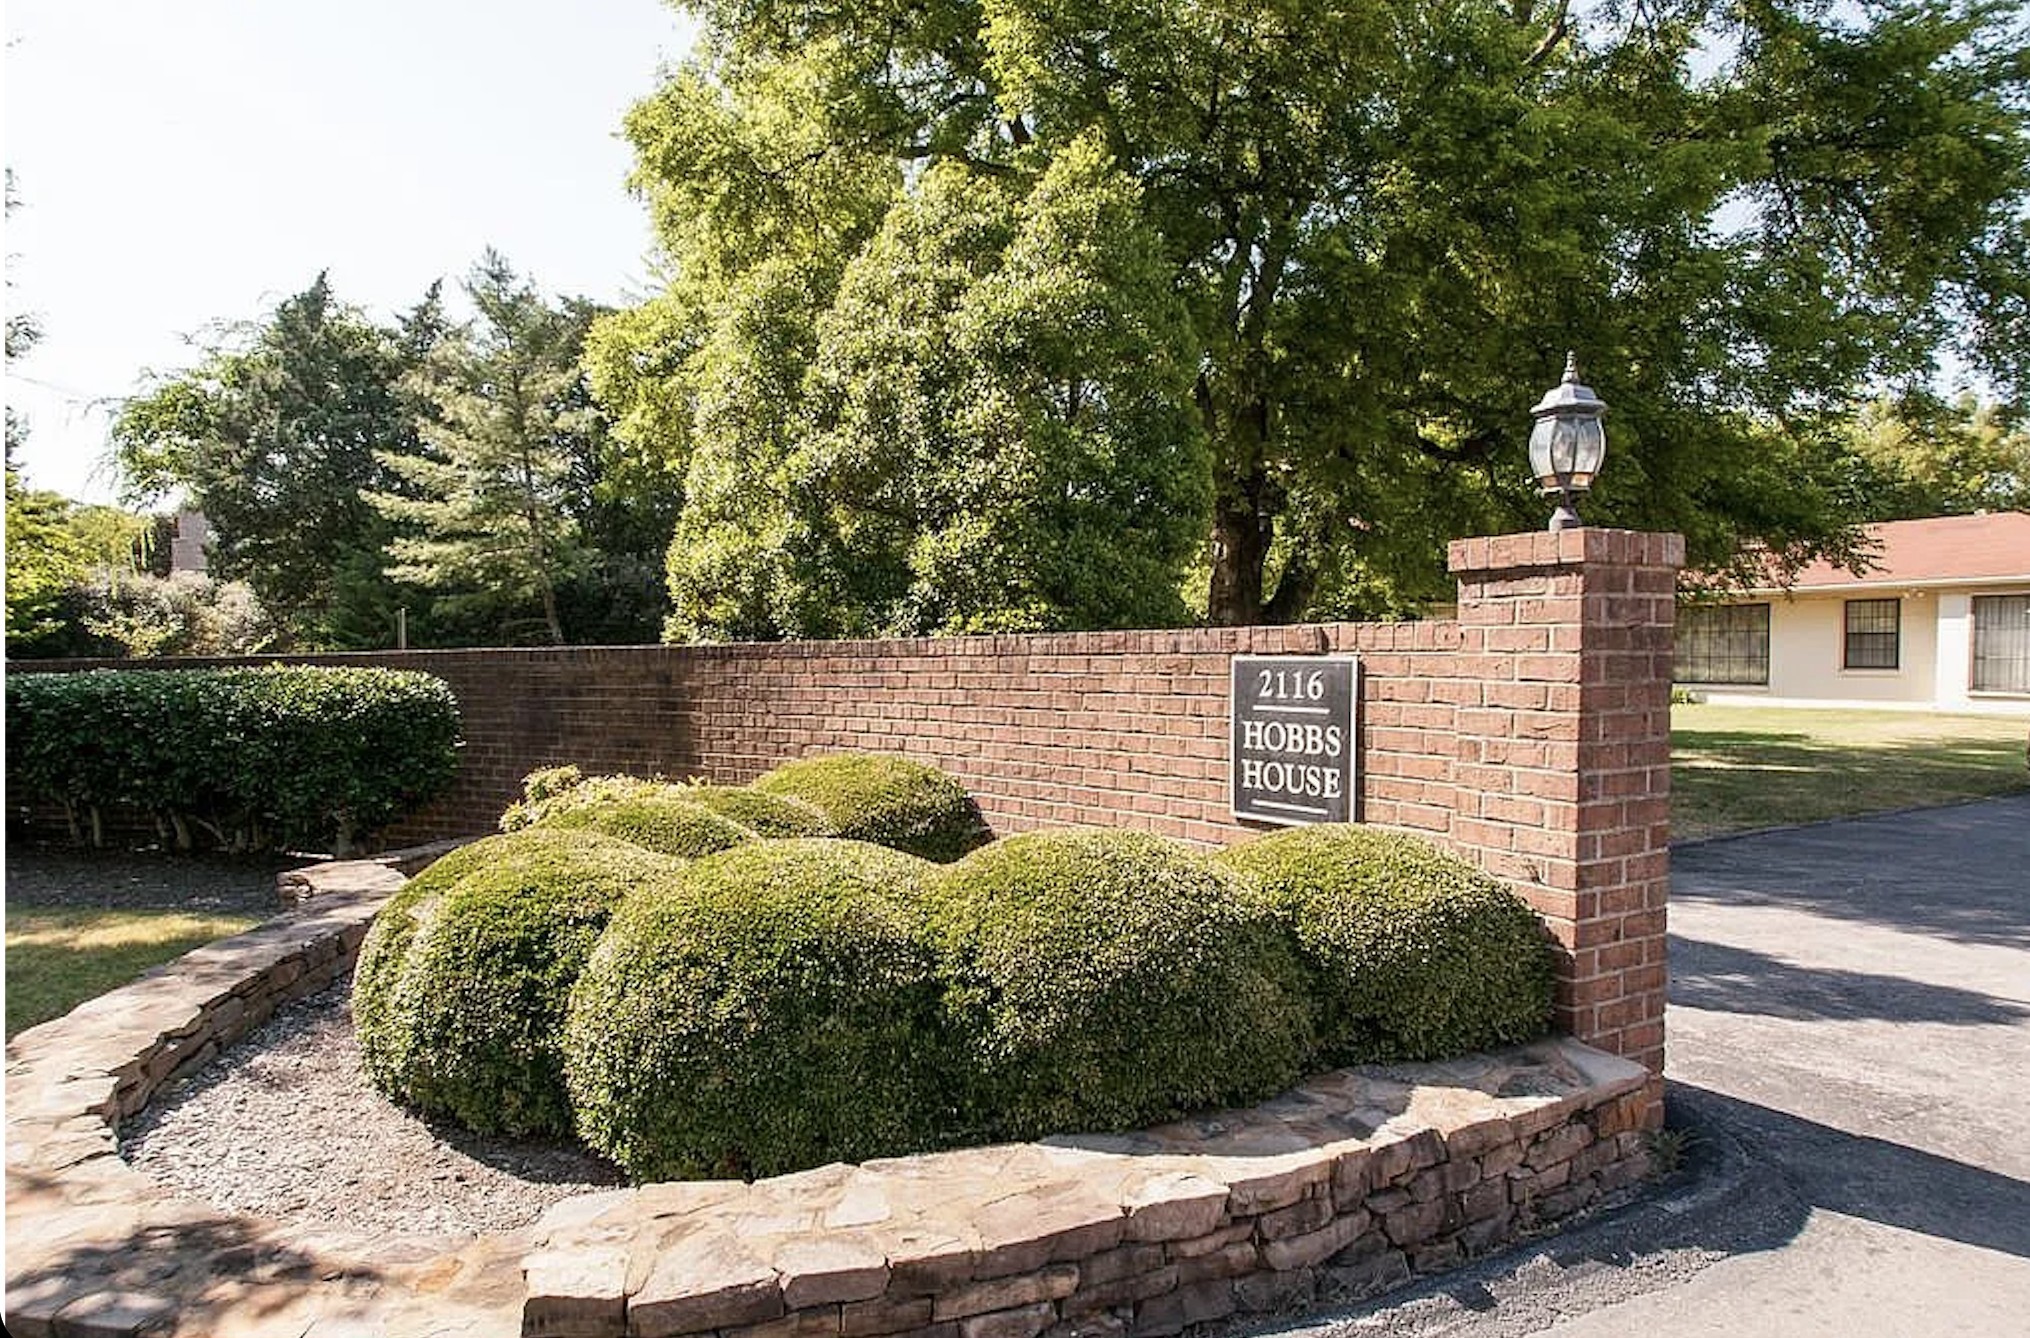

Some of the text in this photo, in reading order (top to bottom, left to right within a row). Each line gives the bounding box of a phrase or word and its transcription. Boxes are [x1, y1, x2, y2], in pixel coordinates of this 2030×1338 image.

[1258, 669, 1324, 700] 2116
[1242, 721, 1341, 757] HOBBS
[1241, 759, 1341, 798] HOUSE
